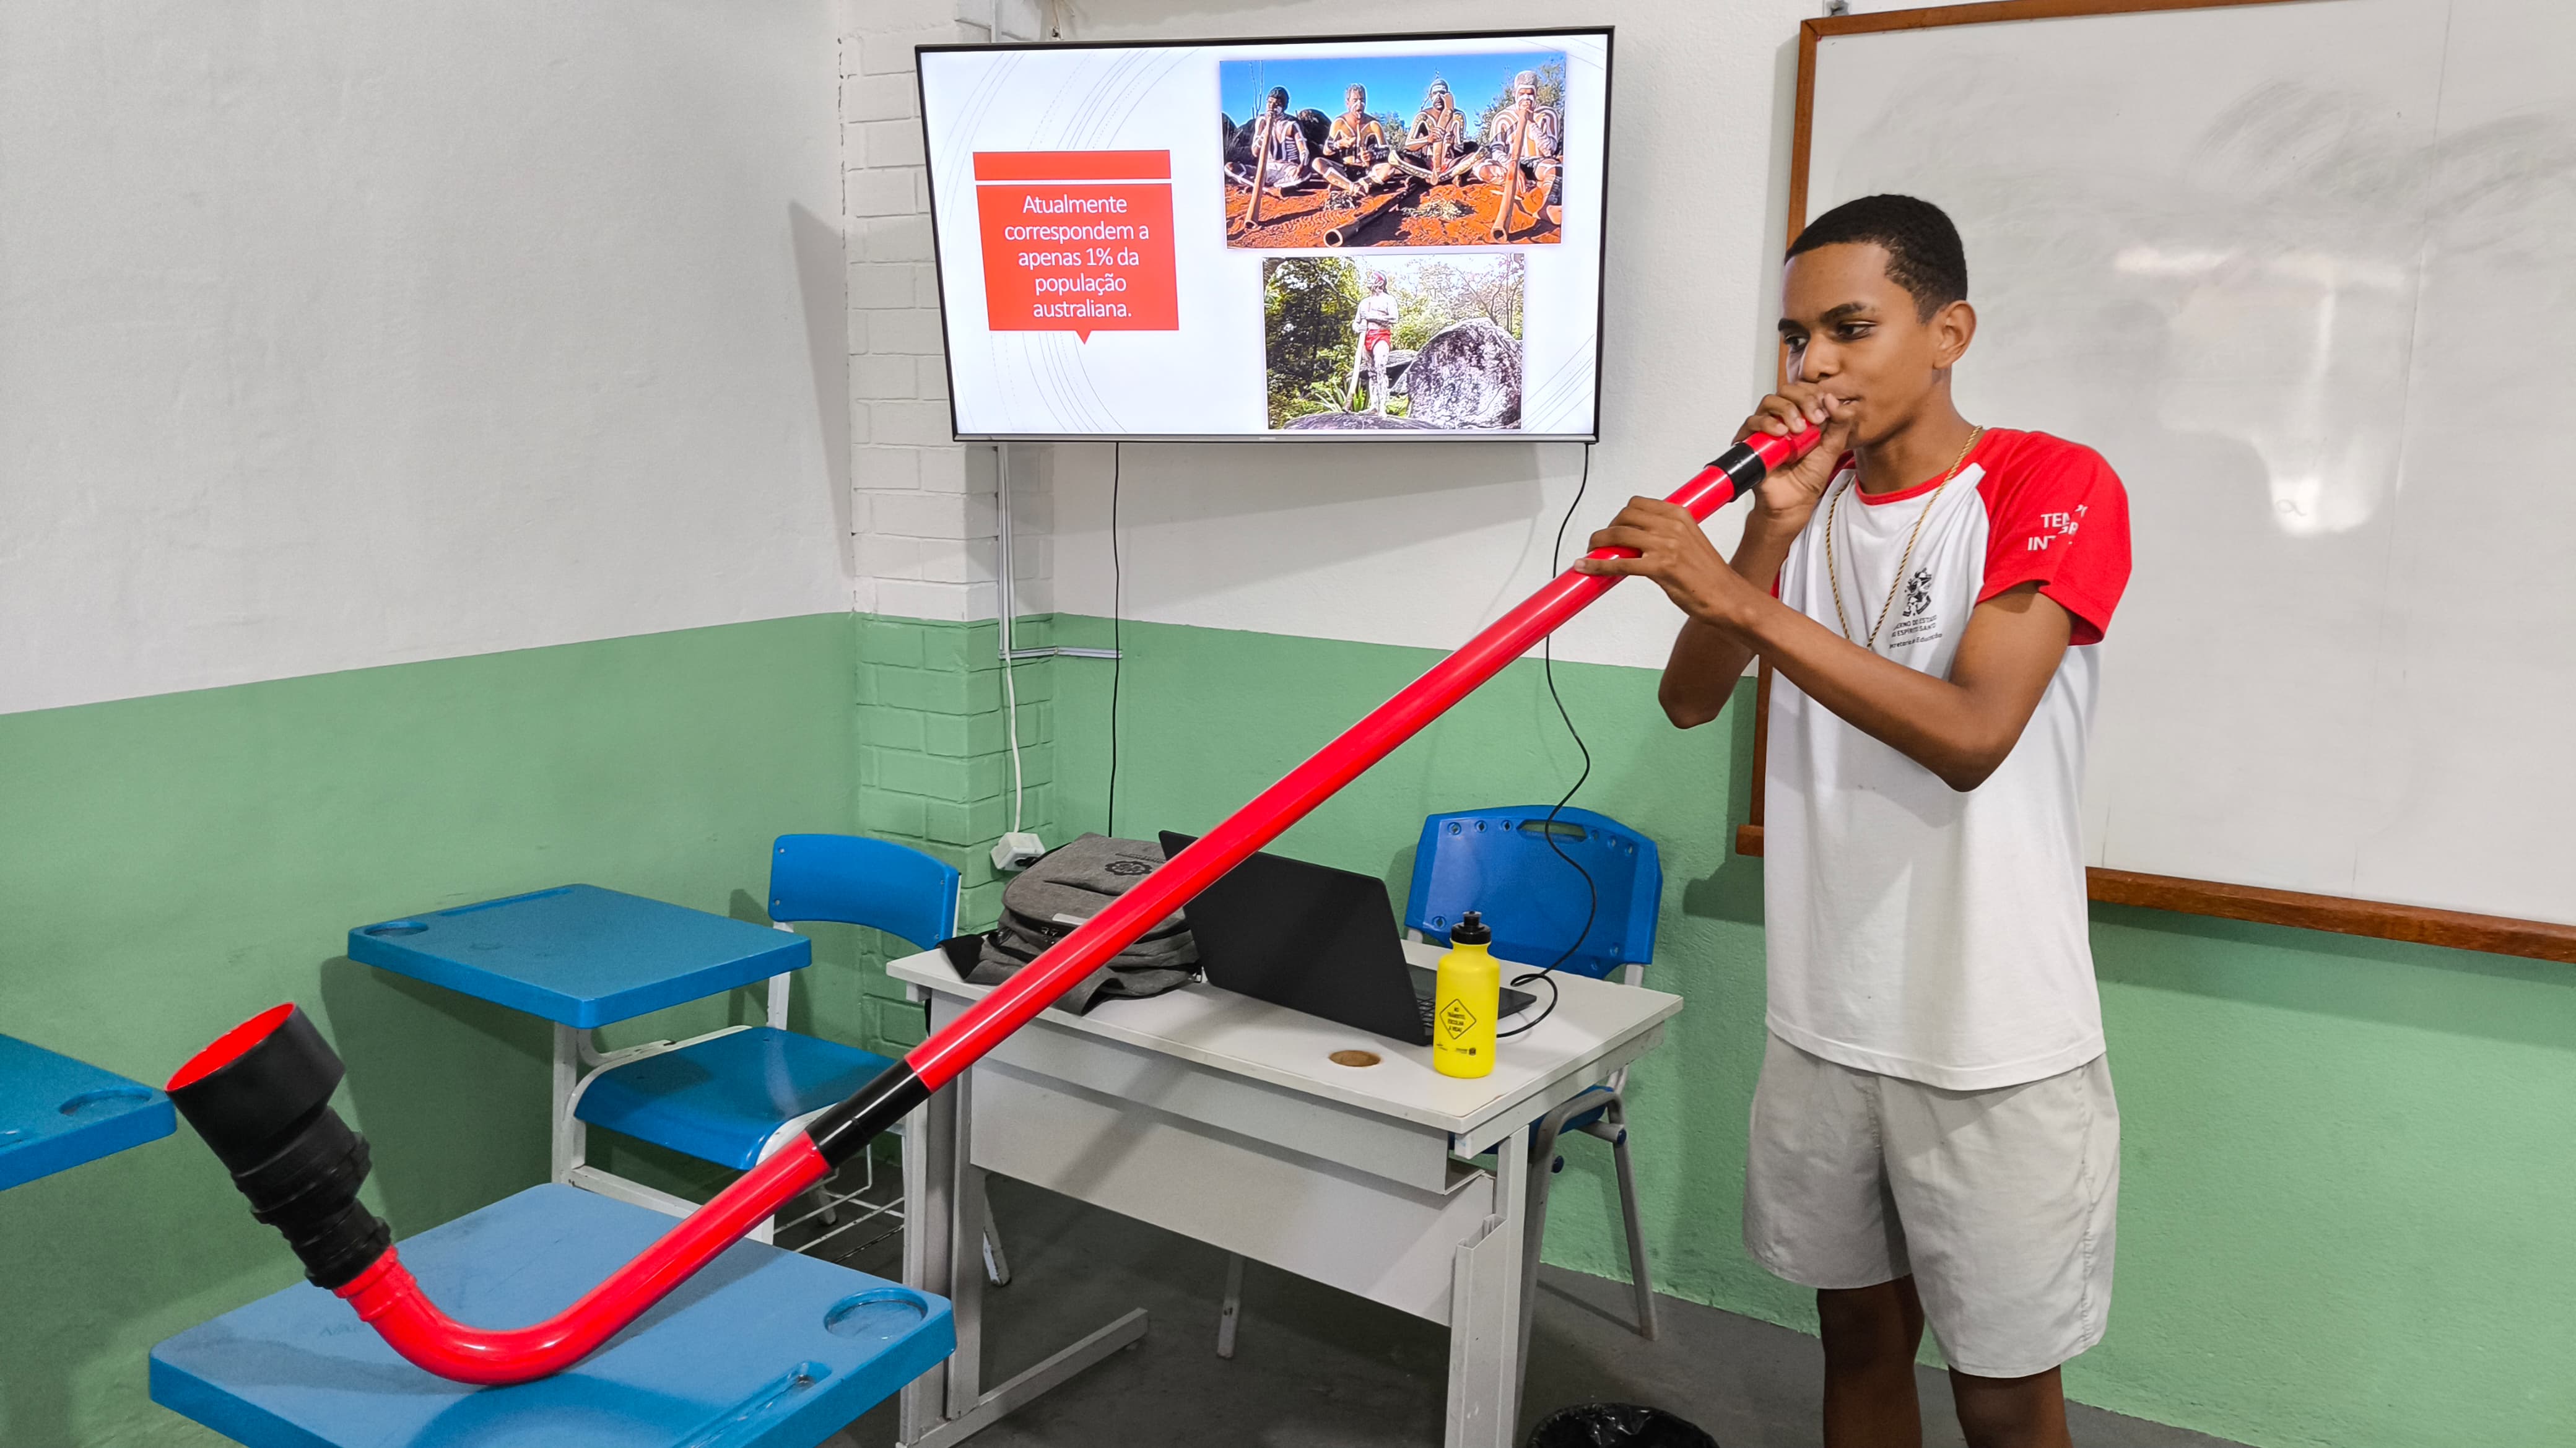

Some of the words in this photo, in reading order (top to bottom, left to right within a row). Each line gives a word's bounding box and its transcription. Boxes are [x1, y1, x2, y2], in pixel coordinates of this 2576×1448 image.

[1022, 194, 1128, 214] Atualmente
[1004, 220, 1134, 245] correspondem
[1138, 225, 1150, 240] a
[1018, 251, 1082, 270] apenas
[1086, 247, 1114, 266] 1%
[1117, 246, 1139, 266] da
[1035, 272, 1127, 296] população
[1032, 298, 1132, 318] australiana.
